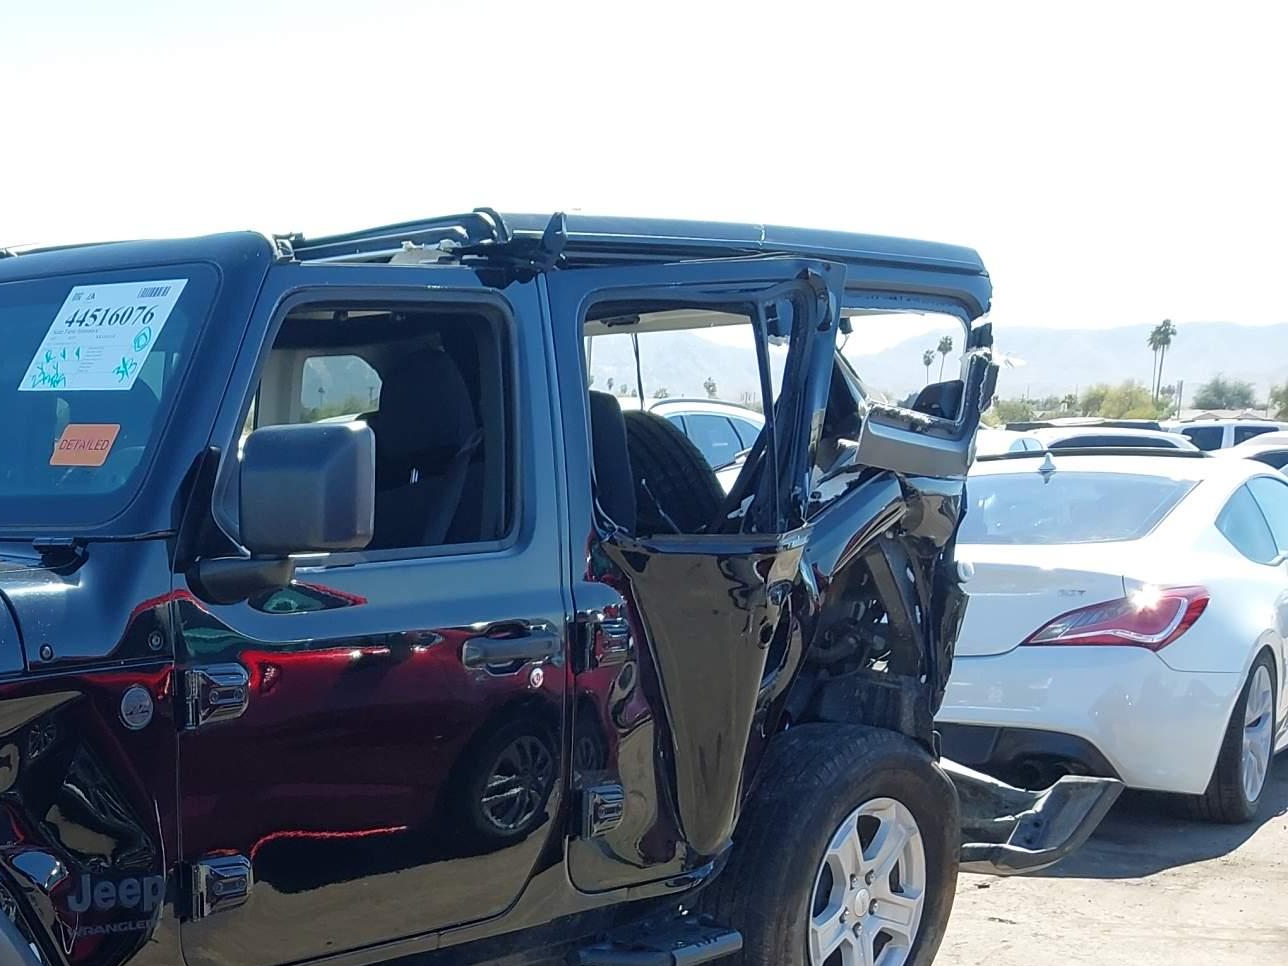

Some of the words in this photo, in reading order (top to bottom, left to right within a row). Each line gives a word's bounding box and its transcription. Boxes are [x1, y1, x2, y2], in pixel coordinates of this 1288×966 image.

[65, 304, 159, 328] 44516076
[59, 439, 110, 451] DETAILED
[67, 874, 164, 913] Jeep
